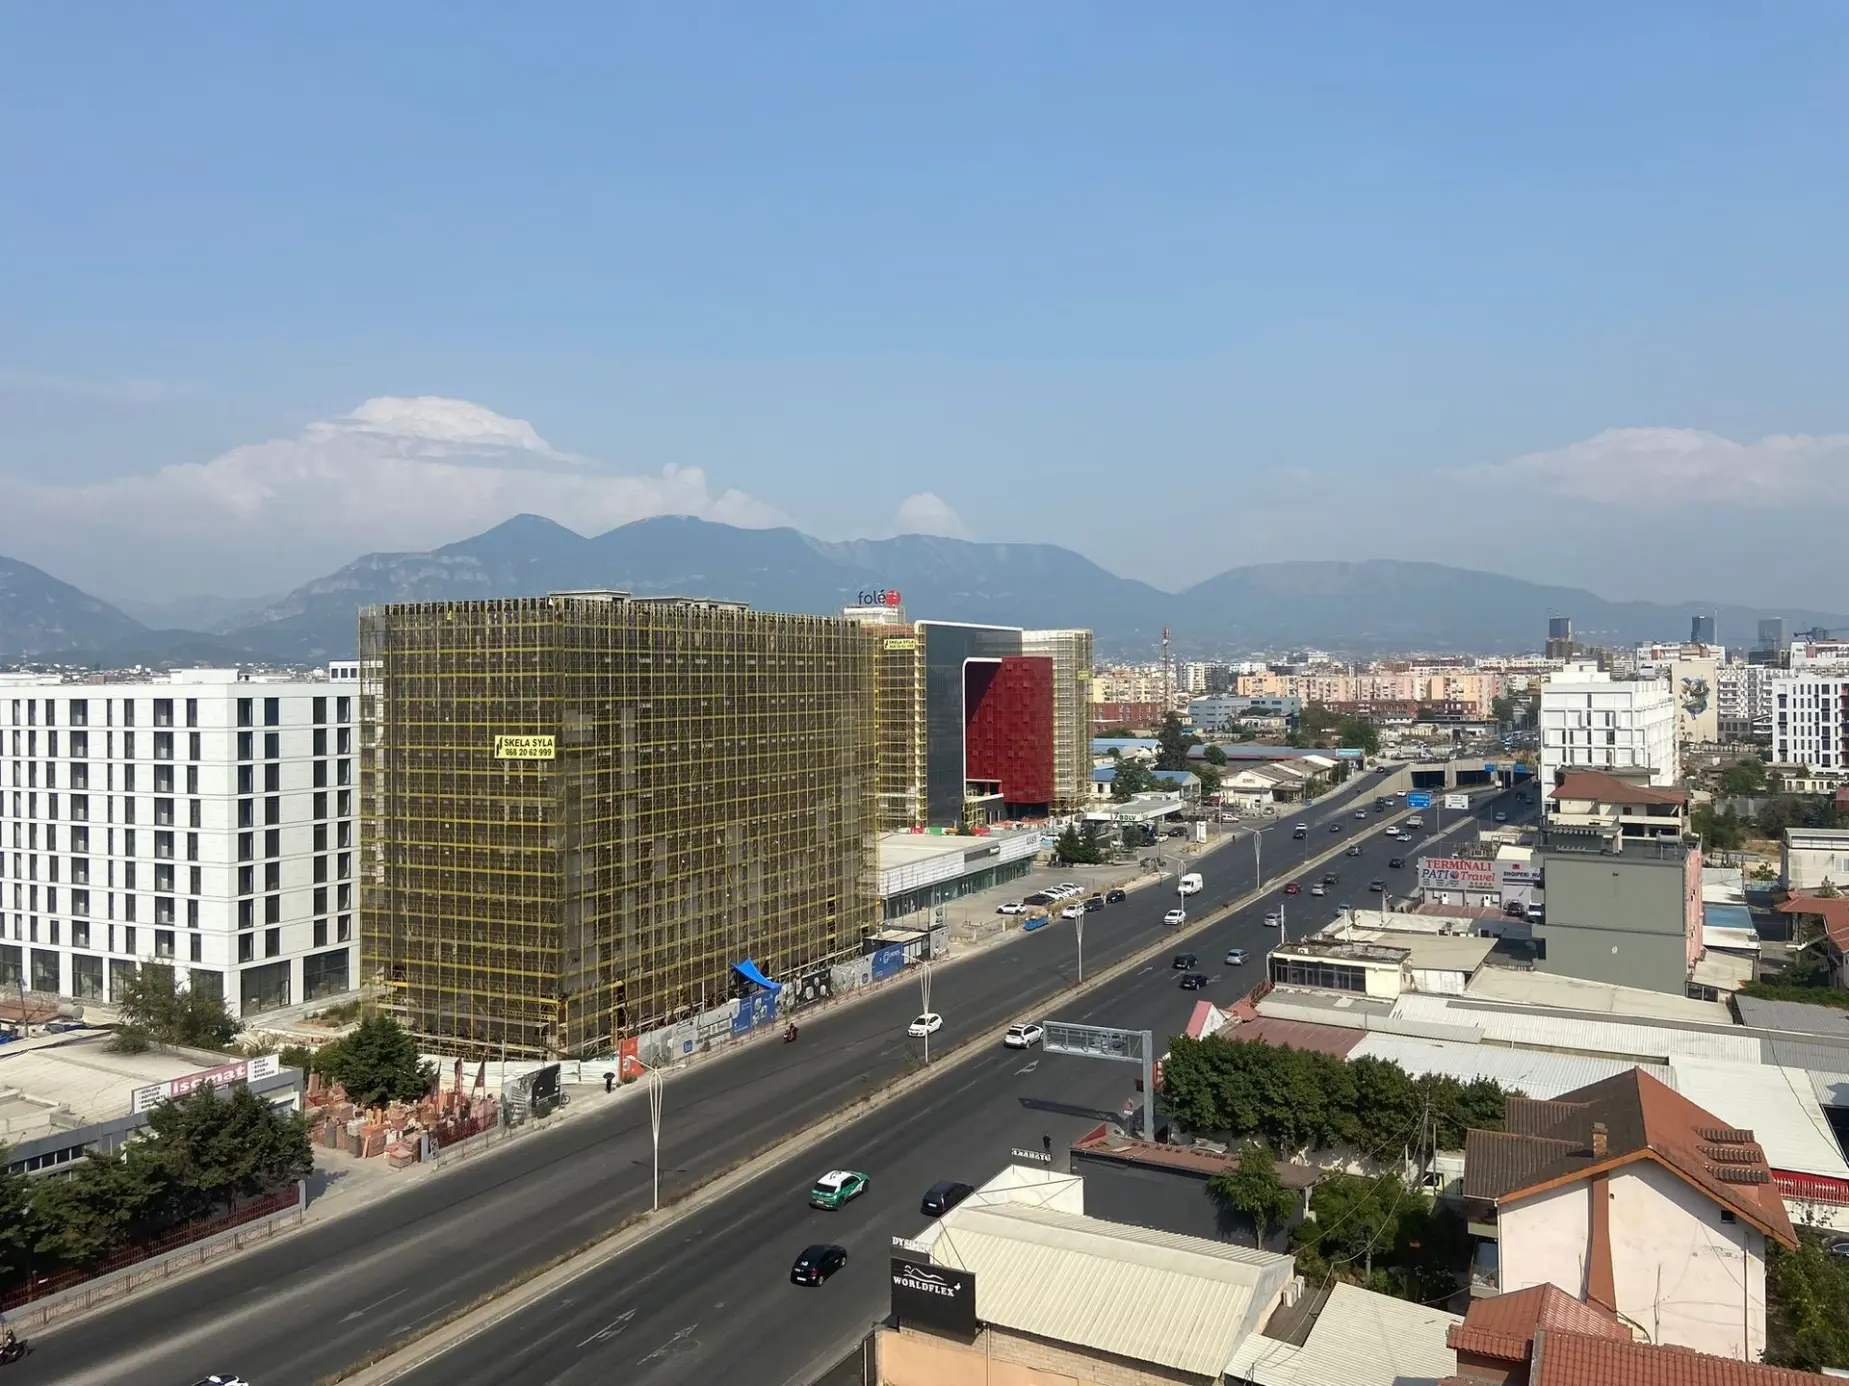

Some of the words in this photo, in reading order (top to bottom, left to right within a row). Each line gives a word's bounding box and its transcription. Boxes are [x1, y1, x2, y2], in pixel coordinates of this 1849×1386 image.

[858, 589, 886, 604] folé
[504, 738, 530, 747] SKELA
[532, 738, 553, 747] SYLA
[519, 748, 527, 756] 20
[529, 748, 537, 756] 62
[539, 748, 552, 757] 999
[1460, 871, 1495, 882] Travel
[893, 1276, 954, 1297] WORLDFLEX
